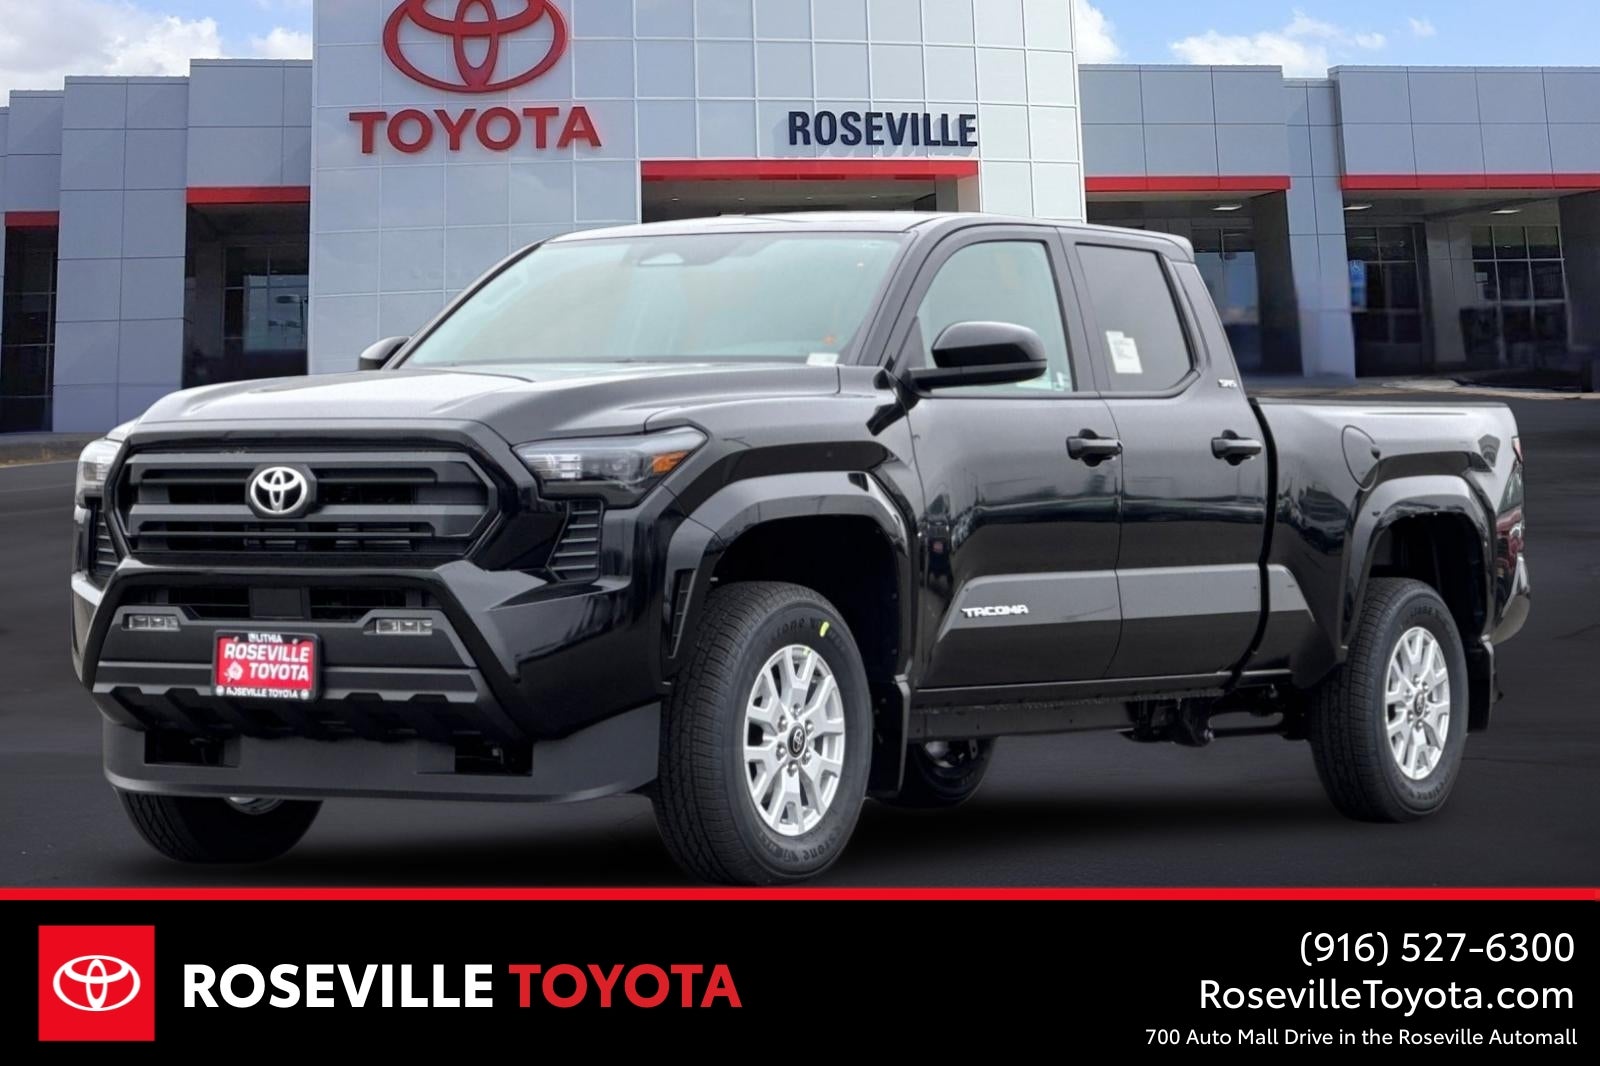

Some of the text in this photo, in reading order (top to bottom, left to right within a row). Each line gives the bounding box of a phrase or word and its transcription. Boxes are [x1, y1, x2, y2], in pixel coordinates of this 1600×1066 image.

[348, 106, 602, 154] TOYOTA
[788, 110, 978, 147] ROSEVILLE
[961, 604, 1029, 618] TACOMA
[224, 643, 310, 662] ROSEVILLE
[249, 663, 309, 681] TOYOTA
